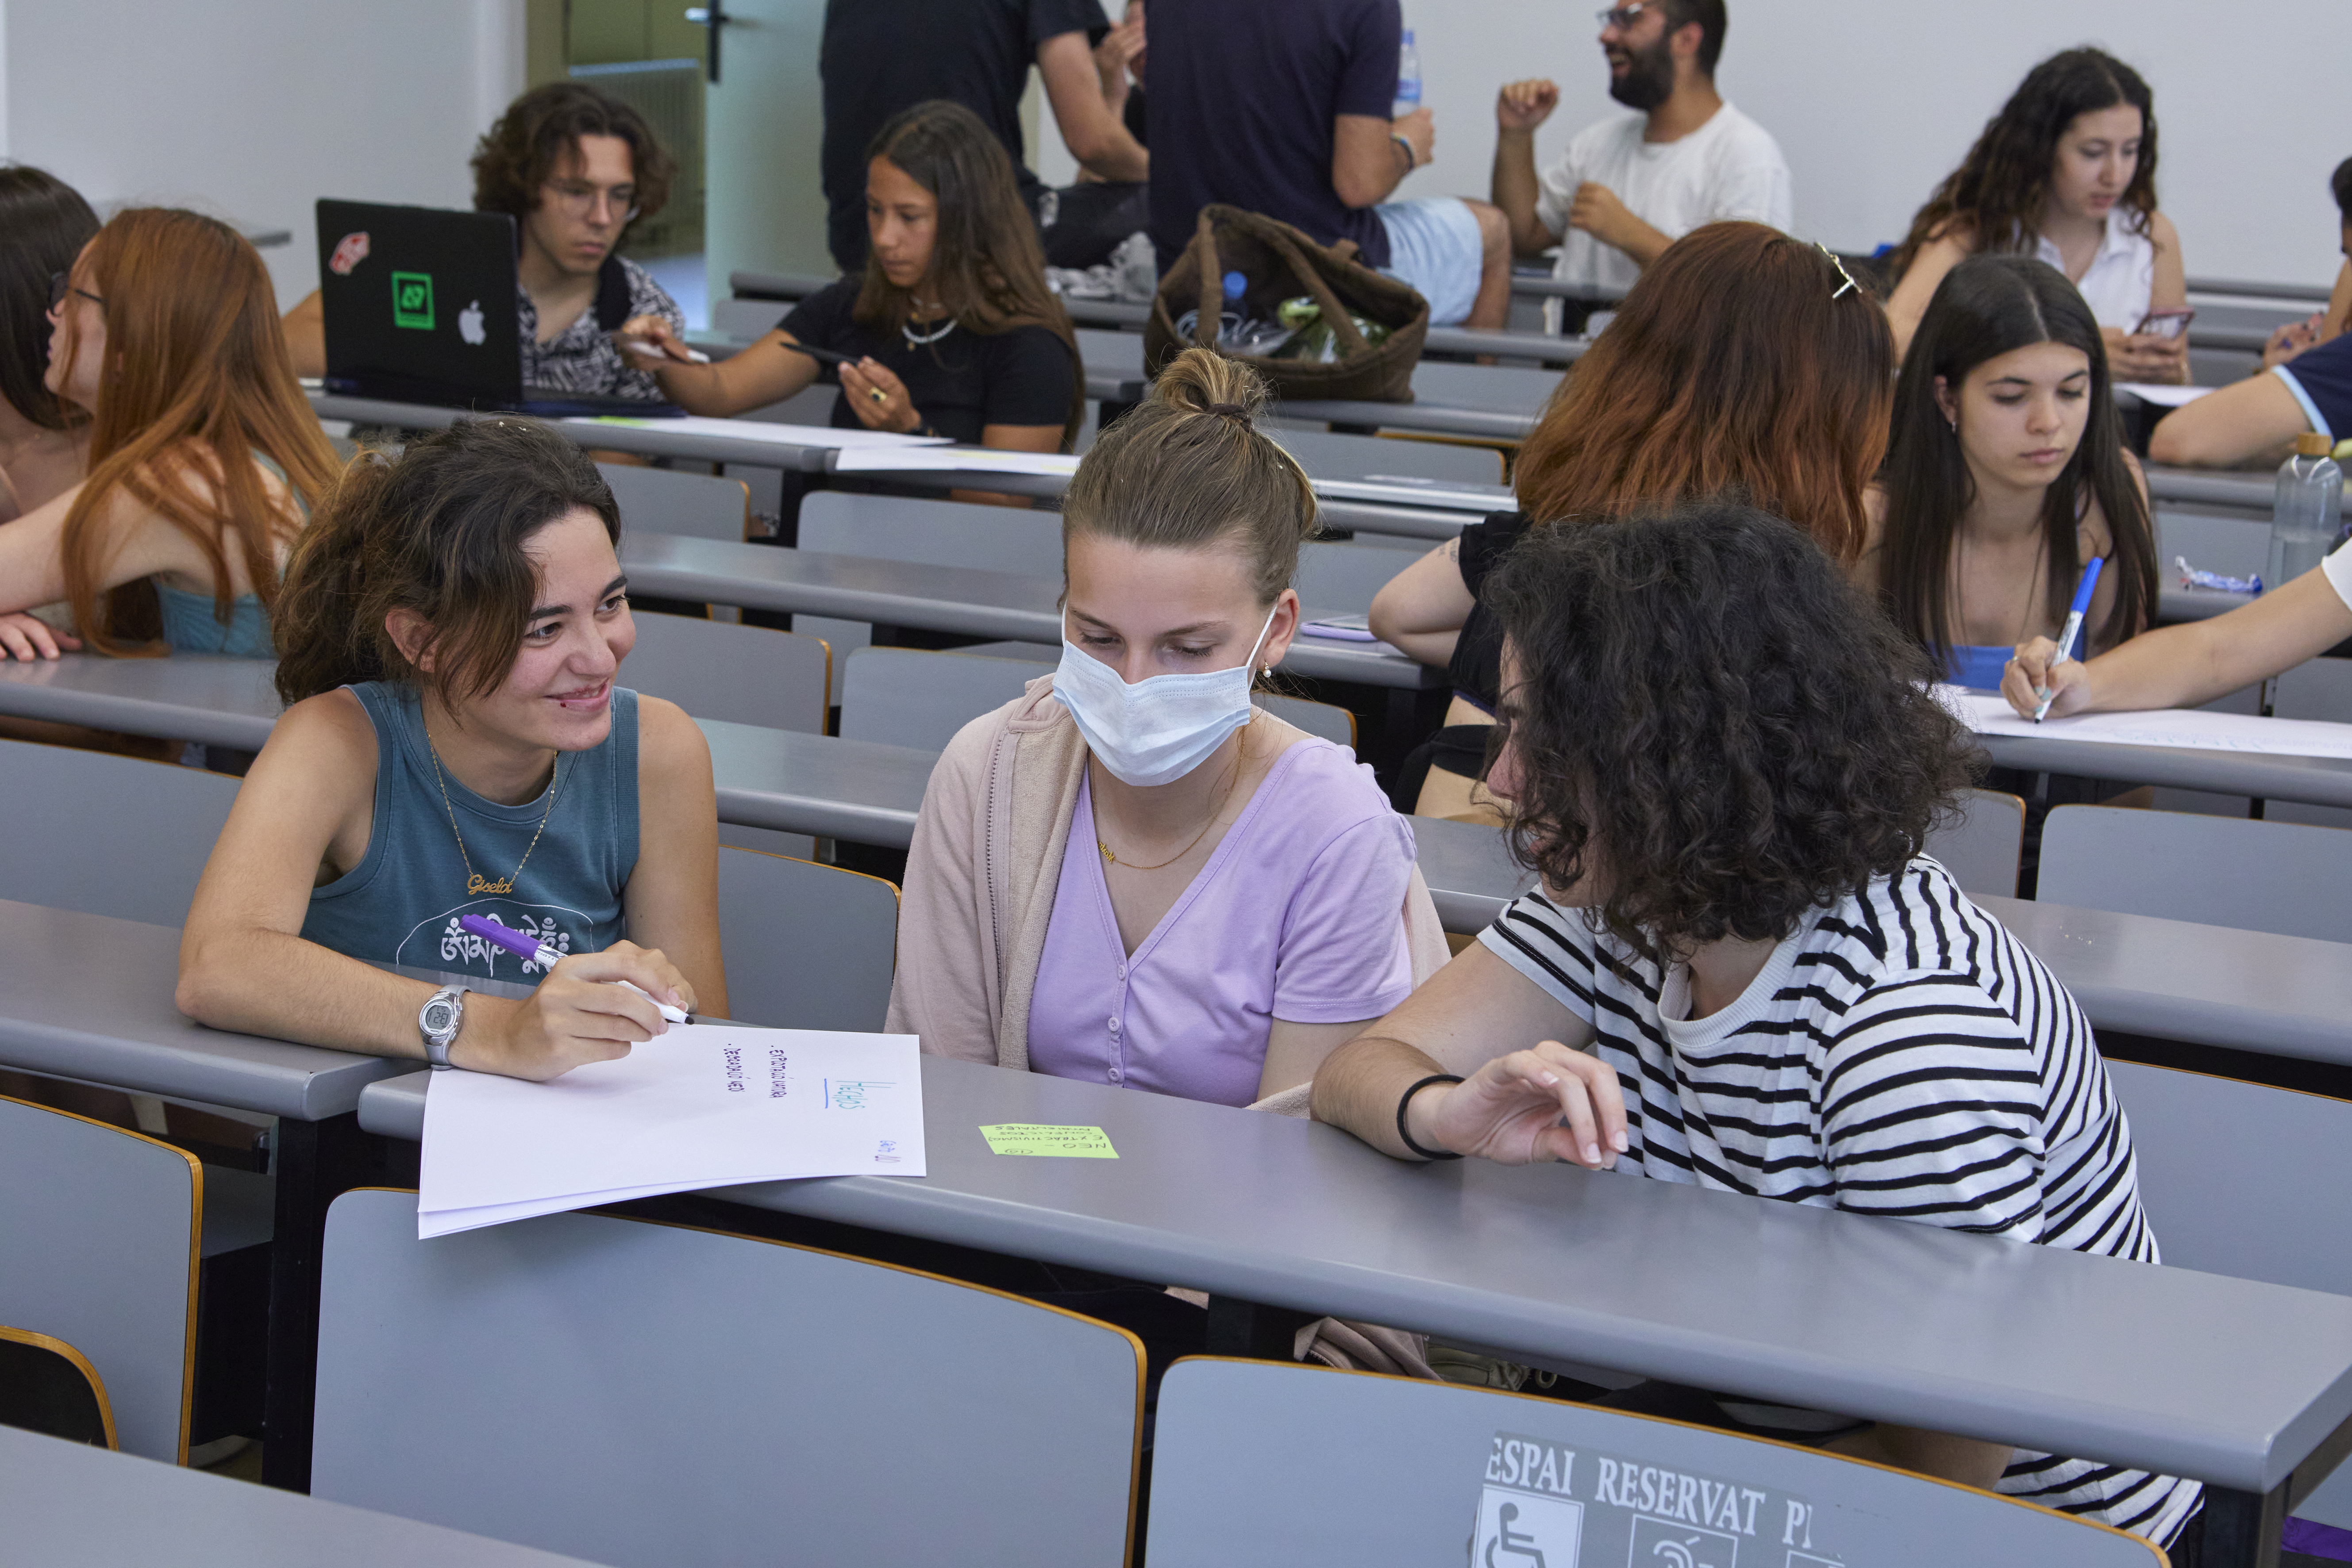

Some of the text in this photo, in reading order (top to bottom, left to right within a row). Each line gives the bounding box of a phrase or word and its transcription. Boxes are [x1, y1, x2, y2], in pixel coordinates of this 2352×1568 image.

[467, 874, 512, 895] Gisela
[769, 1080, 787, 1098] NATURA
[1485, 1437, 1575, 1495] ESPAI
[1594, 1457, 1766, 1536] RESERVAT
